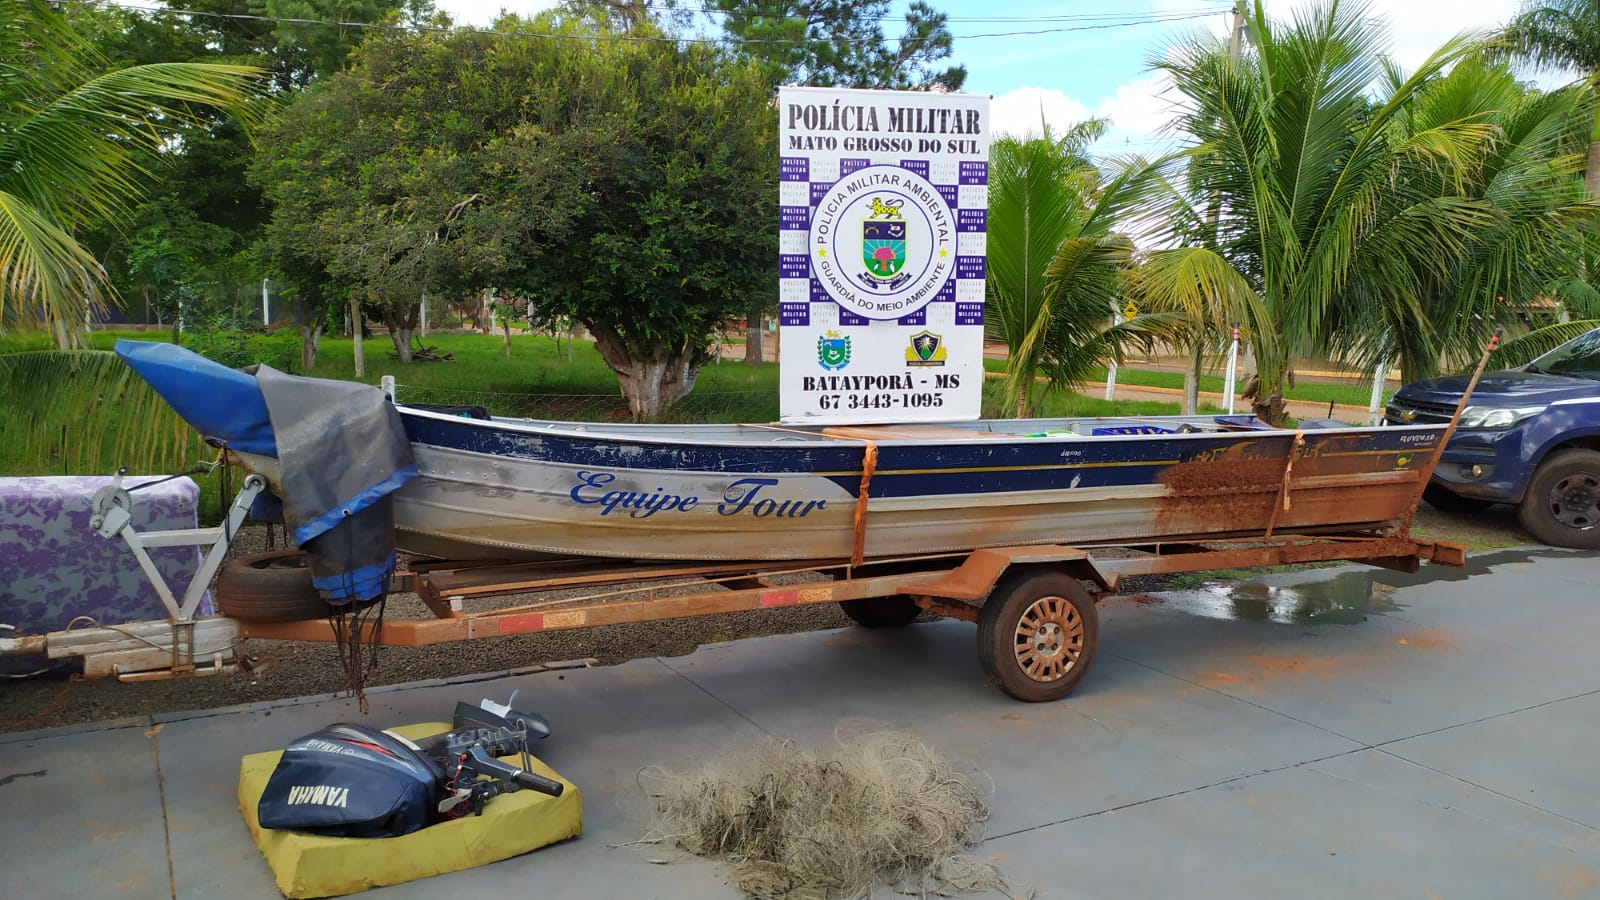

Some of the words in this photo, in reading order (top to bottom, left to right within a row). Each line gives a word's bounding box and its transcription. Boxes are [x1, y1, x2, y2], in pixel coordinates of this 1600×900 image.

[788, 99, 879, 131] POLÍCIA
[888, 107, 981, 135] MILITAR
[789, 136, 837, 150] MATO
[844, 137, 912, 152] GROSSO
[918, 139, 941, 153] DO
[947, 140, 980, 154] SUL
[818, 192, 847, 244] POLÍCIA
[846, 174, 900, 194] MILITAR
[903, 180, 949, 246] AMBIENTAL
[858, 298, 874, 310] DO
[876, 300, 903, 311] MEIO
[906, 262, 945, 306] AMBIENTE
[803, 372, 913, 391] BATAYPORÃ
[935, 374, 960, 388] MS
[819, 394, 841, 410] 67
[848, 392, 943, 409] 3443-1095
[570, 470, 699, 518] Equipe
[718, 478, 828, 518] Tour
[306, 739, 344, 754] YAMAHA
[288, 785, 350, 808] YAMAHA
